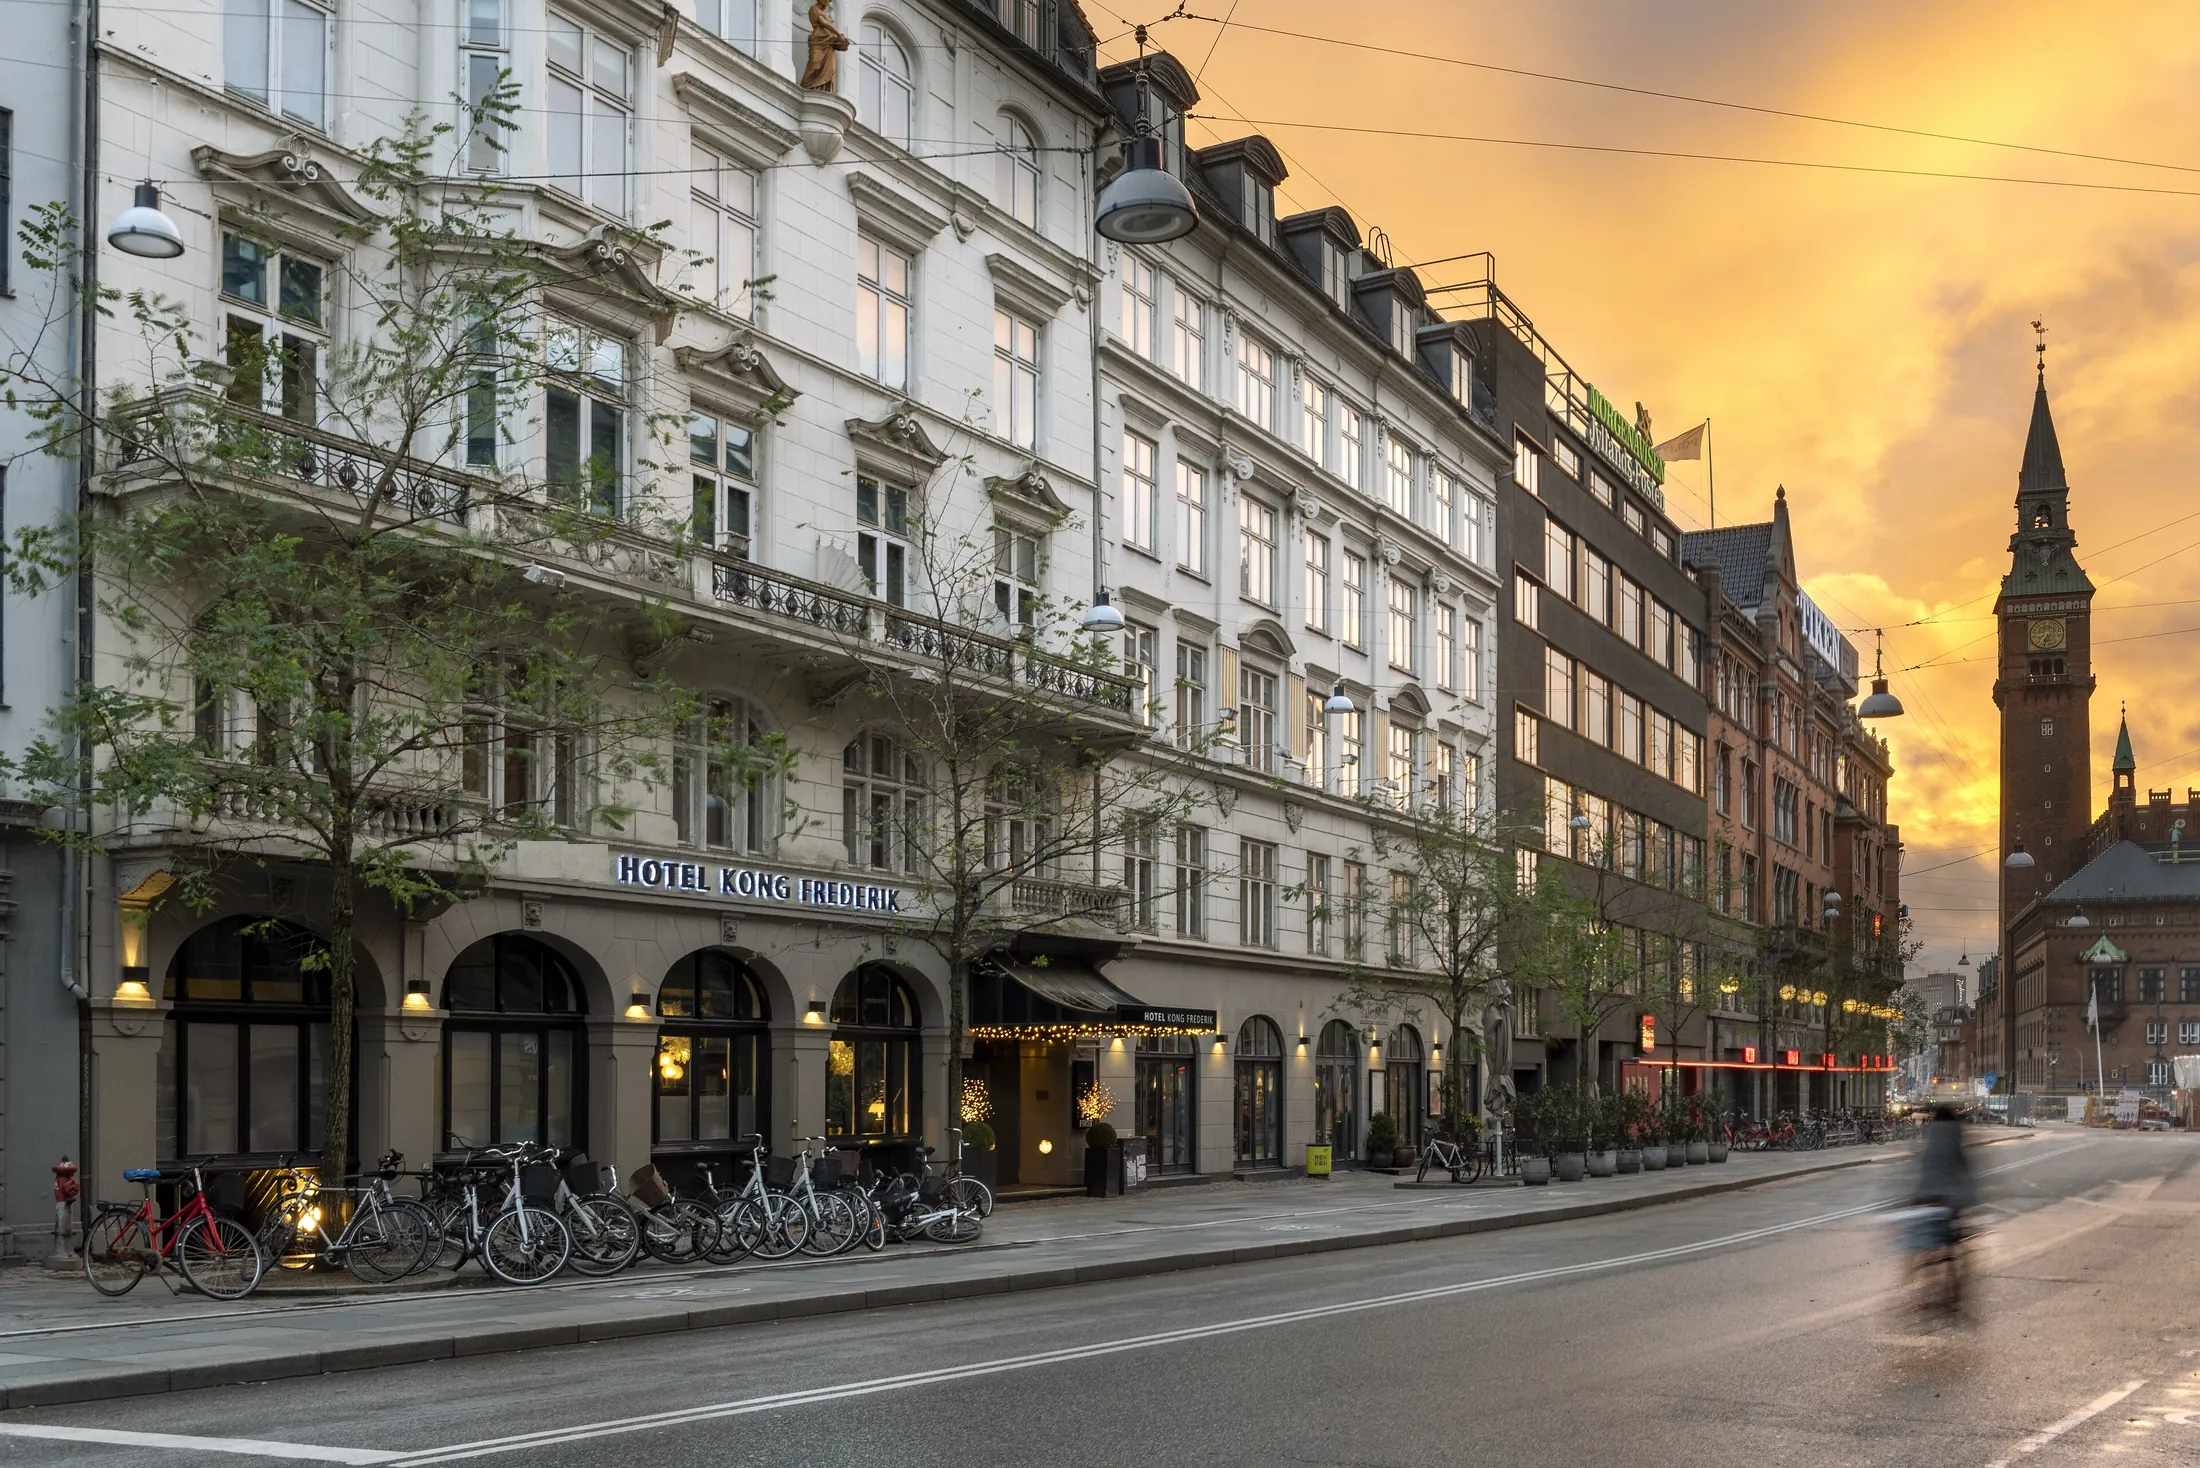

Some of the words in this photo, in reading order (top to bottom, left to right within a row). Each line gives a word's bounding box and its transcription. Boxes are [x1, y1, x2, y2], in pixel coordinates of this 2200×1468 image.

[1589, 383, 1665, 484] MORGENAVISEN
[618, 854, 711, 892] HOTEL
[719, 867, 790, 900] KONG
[799, 877, 901, 913] FREDERIK
[1144, 1011, 1165, 1021] HOTEL
[1167, 1013, 1185, 1023] KONG
[1186, 1014, 1214, 1024] FREDERIK
